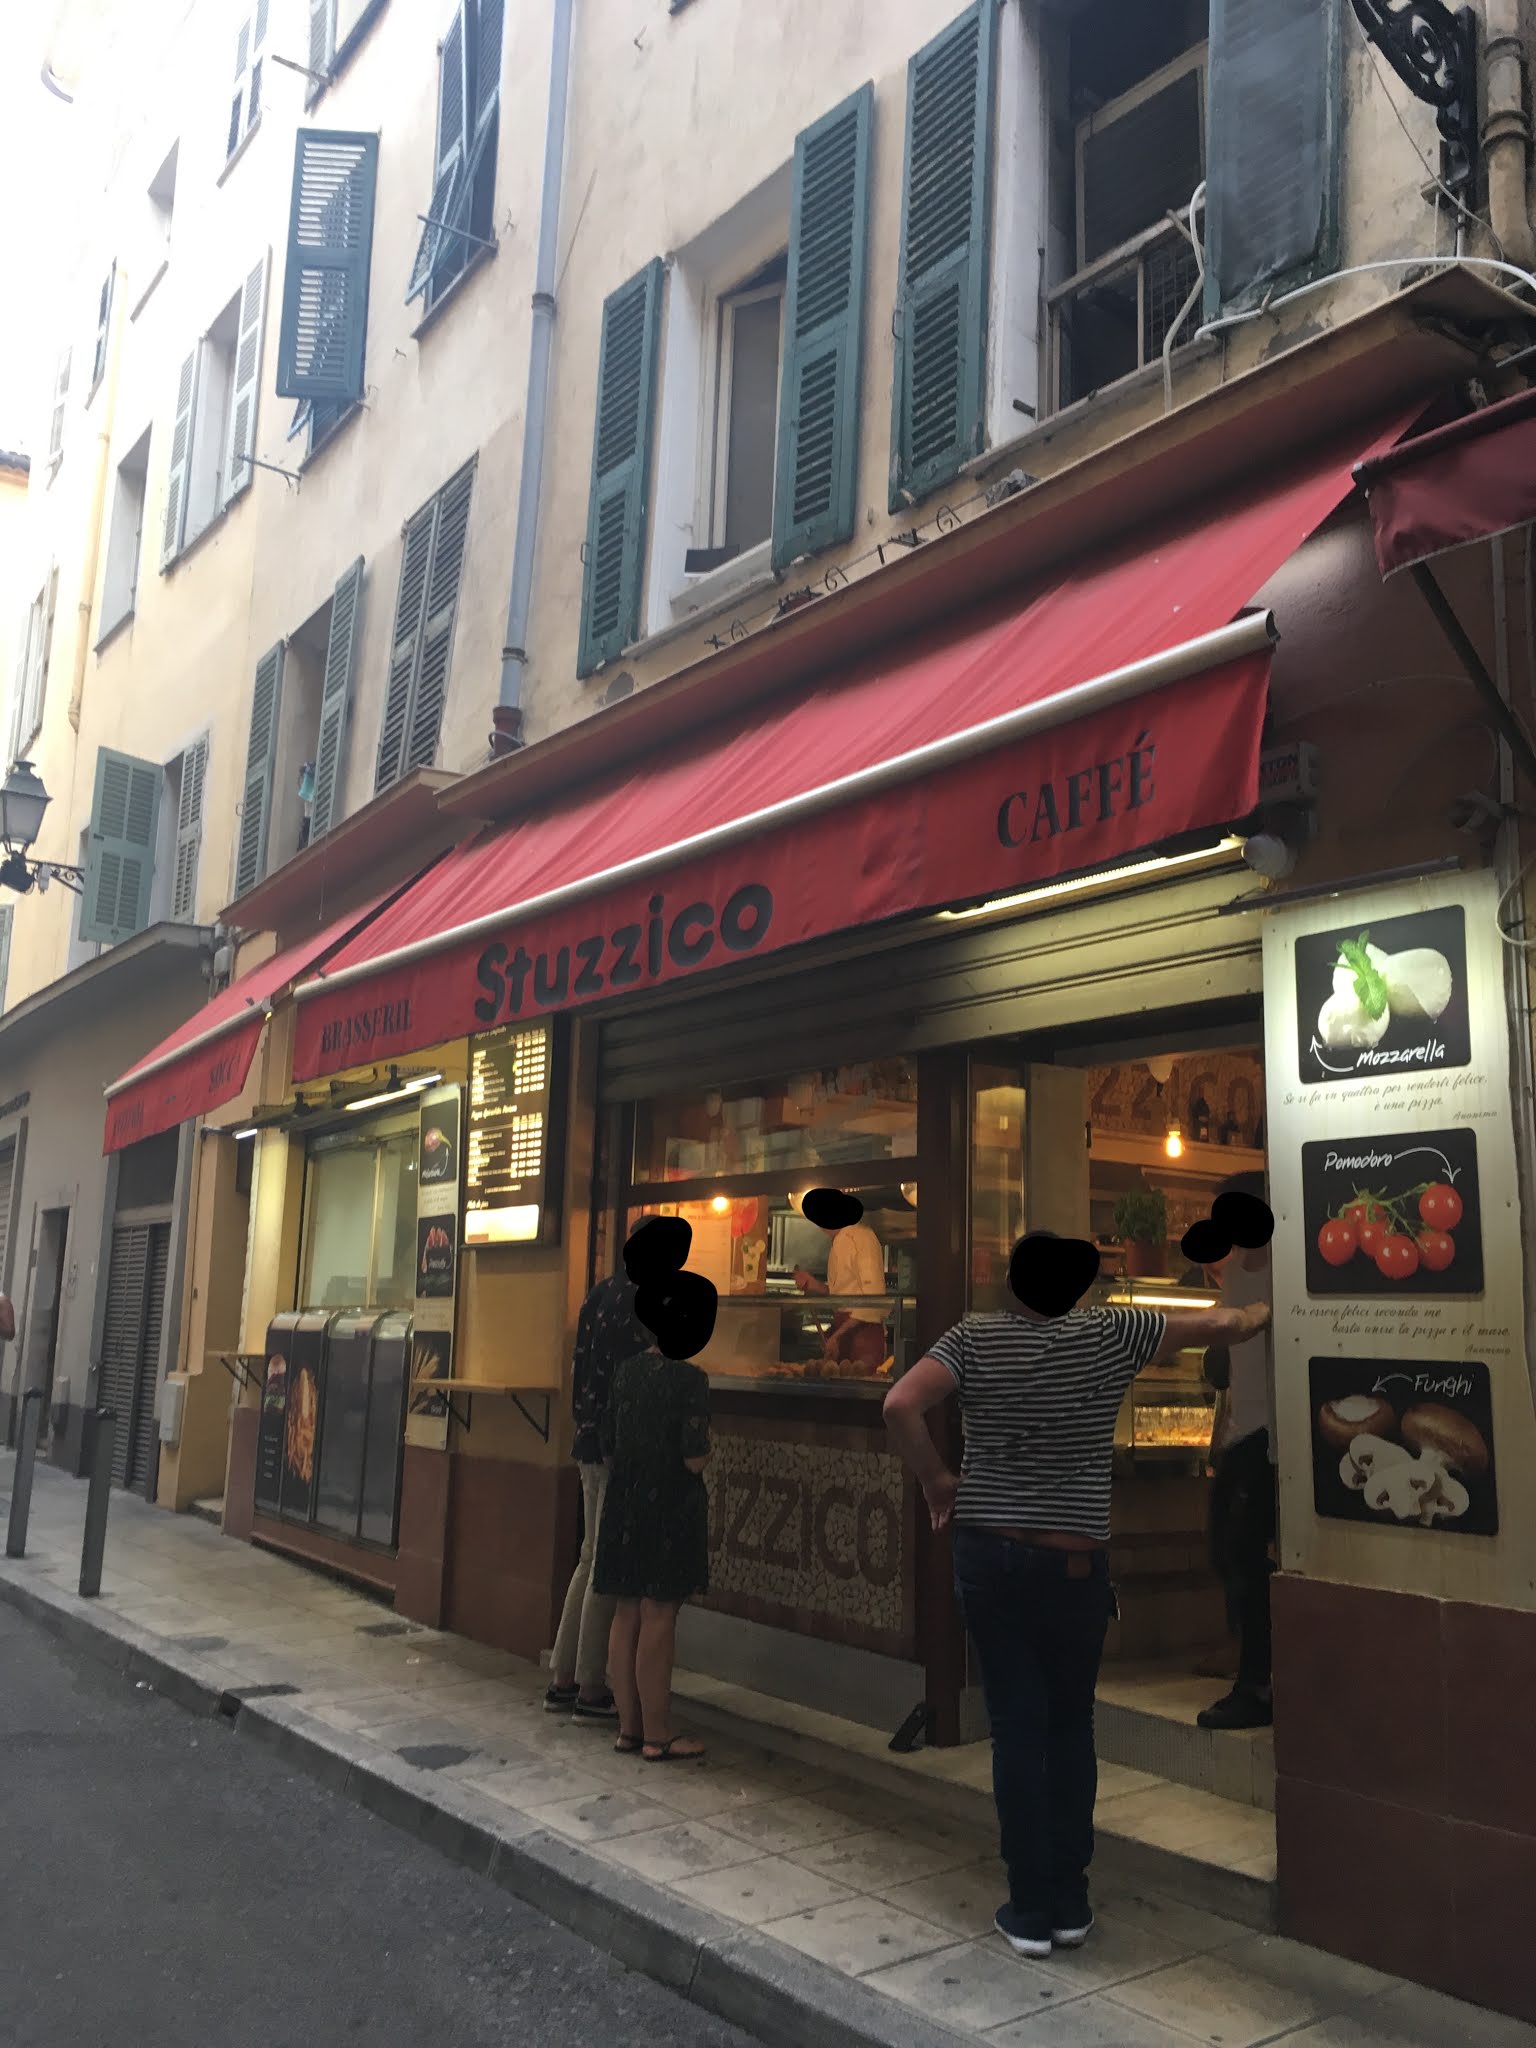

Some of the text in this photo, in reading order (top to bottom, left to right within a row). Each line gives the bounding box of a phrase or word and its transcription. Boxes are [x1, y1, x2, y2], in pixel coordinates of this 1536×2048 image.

[997, 730, 1157, 849] CAFFÉ
[475, 884, 773, 1022] Stuzzico
[1356, 1038, 1445, 1068] Mozzarella
[1283, 1092, 1294, 1105] Se
[1309, 1090, 1321, 1106] fa
[1325, 1090, 1337, 1100] in
[1341, 1085, 1380, 1102] quattro
[1382, 1084, 1401, 1098] per
[1384, 1101, 1405, 1110] una
[1324, 1148, 1393, 1172] Pomodoro
[1290, 1304, 1441, 1320] Per essere felici secondo me
[1332, 1321, 1361, 1334] basta
[1364, 1325, 1394, 1334] unire
[1398, 1321, 1410, 1335] la
[1411, 1327, 1446, 1340] pizza
[1450, 1327, 1457, 1335] e
[1462, 1323, 1475, 1335] il
[1414, 1373, 1474, 1398] Funghi
